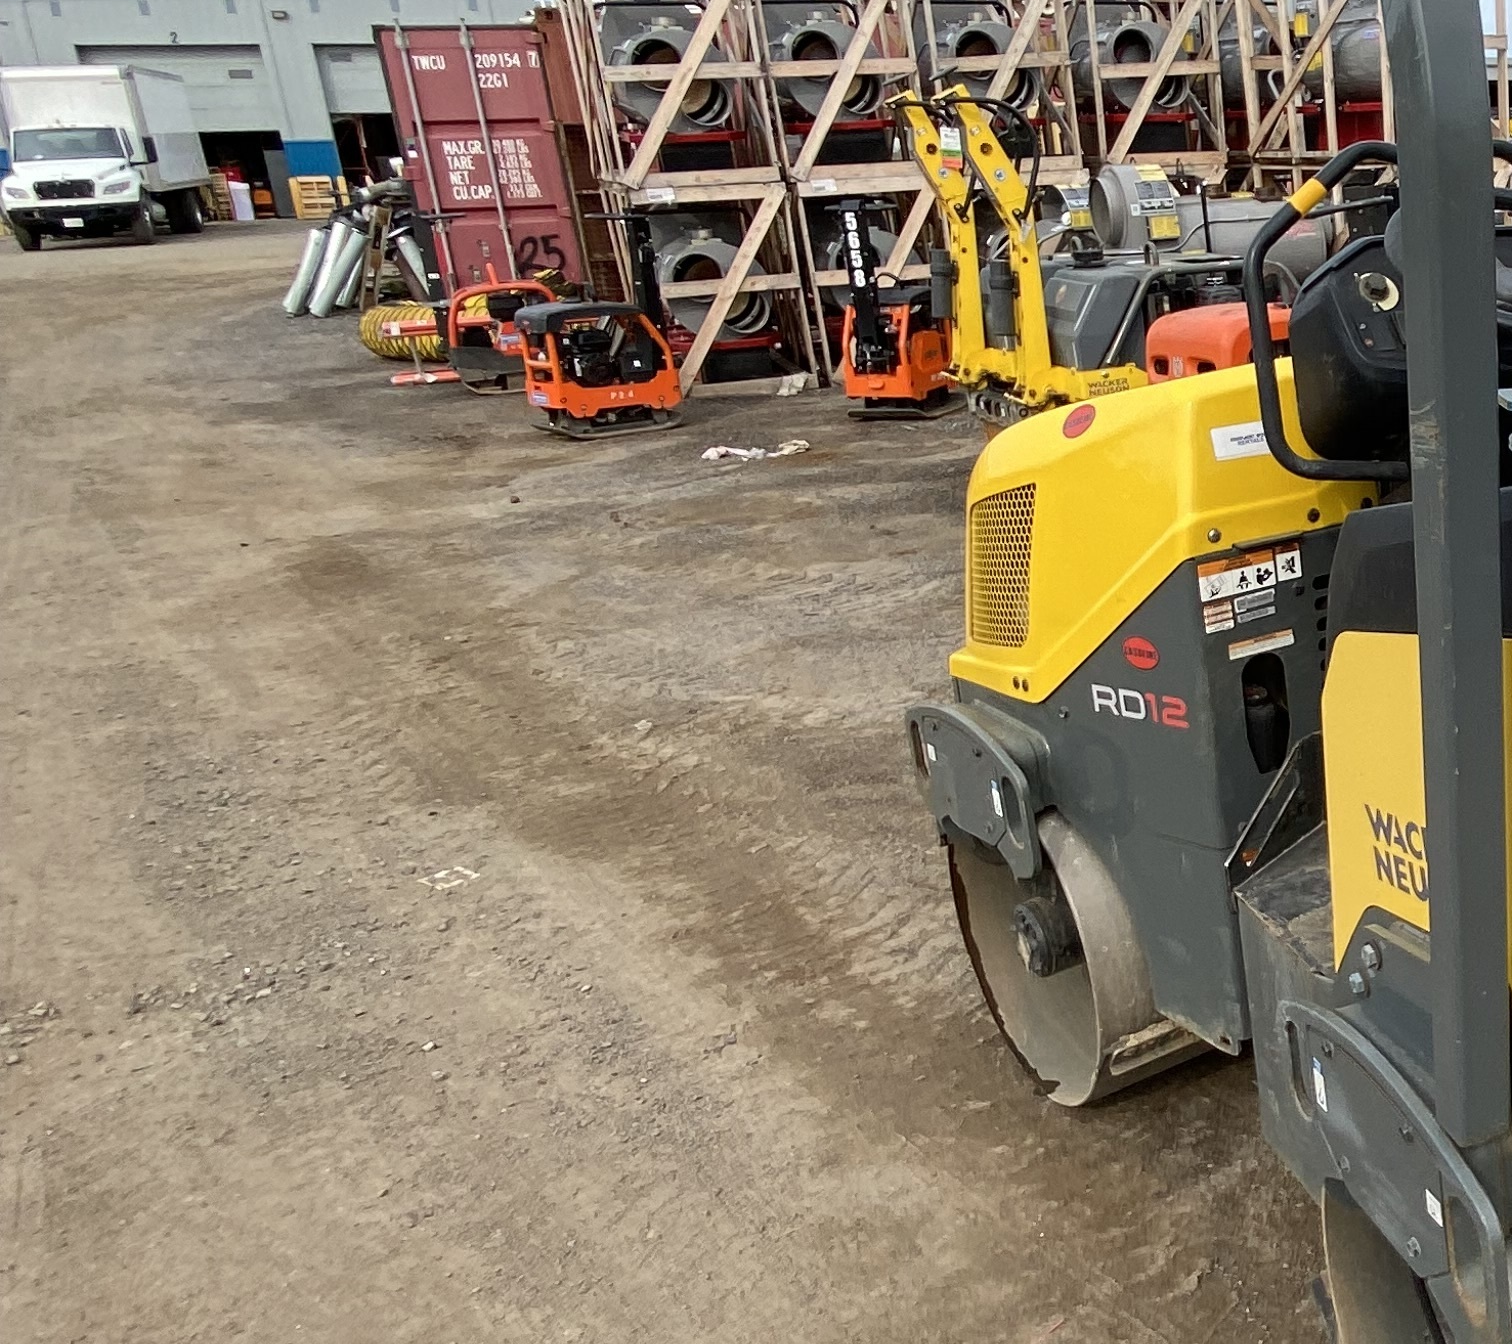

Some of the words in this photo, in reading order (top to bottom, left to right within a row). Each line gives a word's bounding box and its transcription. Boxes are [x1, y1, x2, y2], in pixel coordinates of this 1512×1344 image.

[411, 55, 446, 70] TWCU
[474, 52, 521, 69] 209154
[526, 50, 540, 69] 7
[478, 73, 509, 88] 22G1
[446, 155, 475, 170] TARE
[448, 170, 470, 185] NET
[518, 234, 566, 276] 25
[844, 211, 866, 288] 5658
[1091, 683, 1190, 728] RD12
[1364, 803, 1427, 861] WAC
